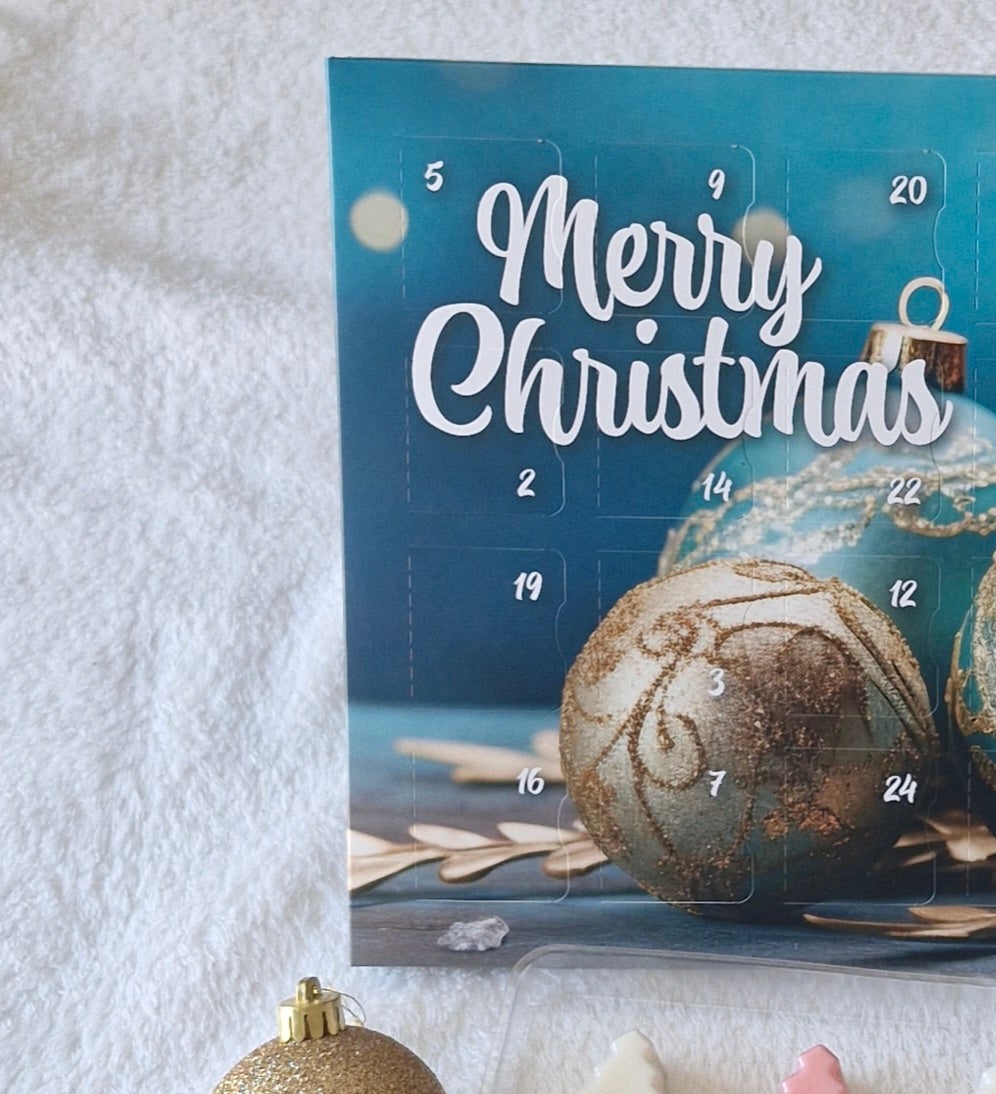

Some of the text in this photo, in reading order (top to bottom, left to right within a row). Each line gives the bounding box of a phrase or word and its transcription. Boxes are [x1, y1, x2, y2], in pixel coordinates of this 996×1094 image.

[425, 161, 444, 192] 5
[708, 169, 725, 200] 9
[889, 175, 927, 206] 20
[477, 175, 821, 347] Merry
[411, 302, 952, 447] Christmas
[517, 469, 536, 497] 2
[702, 472, 732, 502] 14
[887, 477, 921, 505] 22
[513, 571, 542, 601] 19
[889, 579, 918, 608] 12
[708, 668, 725, 696] 3
[517, 767, 544, 795] 16
[709, 770, 726, 796] 7
[884, 776, 917, 803] 24
